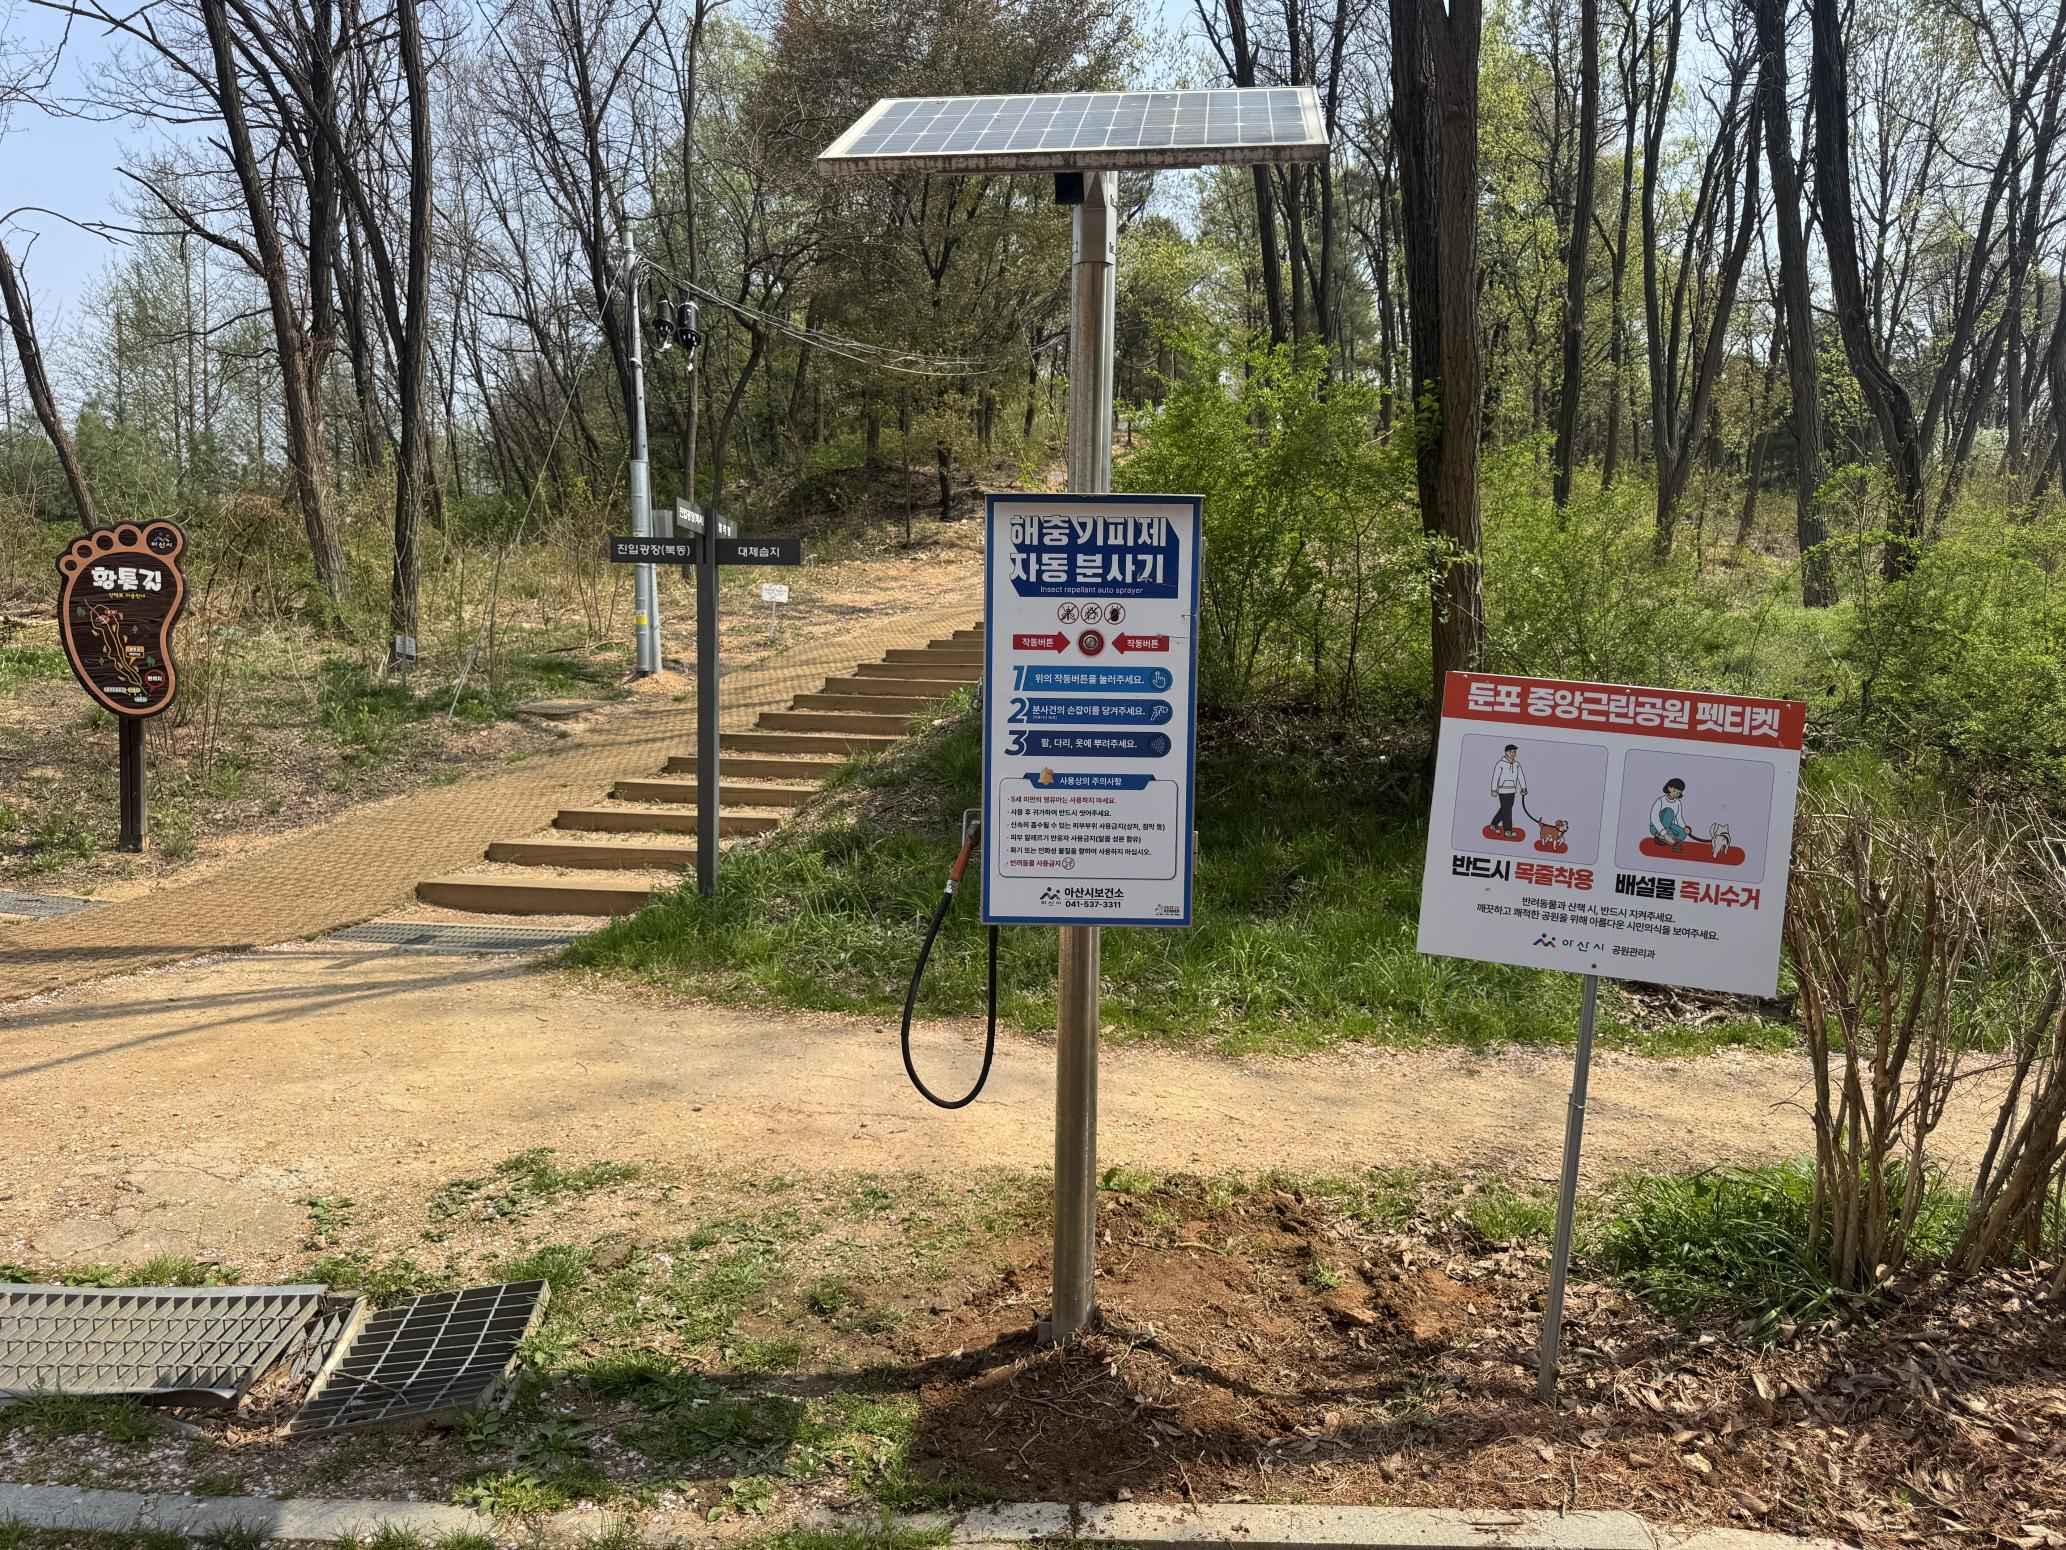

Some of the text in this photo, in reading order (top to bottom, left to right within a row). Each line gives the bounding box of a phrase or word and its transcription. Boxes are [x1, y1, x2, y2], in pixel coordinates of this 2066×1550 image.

[1010, 552, 1164, 583] 자동 분사기
[1098, 586, 1114, 594] auto
[1116, 587, 1144, 596] sprayer
[1022, 638, 1054, 648] 작동버튼
[1127, 639, 1159, 649] 작동버튼
[1012, 665, 1145, 691] 1 위의 작동버튼을 눌러주세요.
[1008, 697, 1028, 723] 2
[1067, 705, 1100, 716] 손잡이를
[1102, 706, 1145, 716] 당겨주세요.
[1468, 681, 1780, 738] 둔포 중앙근린공원 펫티켓
[1005, 730, 1138, 756] 3 팔, 다리, 옷에 뿌려주세요.
[1060, 776, 1122, 786] 사용상의 주의사항
[1059, 809, 1078, 817] 반드시
[1452, 854, 1594, 891] 반드시 목줄착용
[1064, 887, 1125, 899] 아산시보건소
[1615, 873, 1761, 910] 배설물 즉시수거
[1476, 903, 1512, 916] 깨끗하고
[1541, 911, 1568, 923] 공원을
[1570, 914, 1588, 926] 위해
[1589, 917, 1625, 930] 아름다운
[1626, 921, 1671, 936] 시민의식을
[1672, 927, 1720, 940] 보여주세요.
[1522, 896, 1566, 910] 반려동물과
[1568, 902, 1586, 913] 산책
[1600, 906, 1627, 918] 반드시
[1629, 909, 1676, 923] 지켜주세요.
[1611, 945, 1656, 959] 공원관리과
